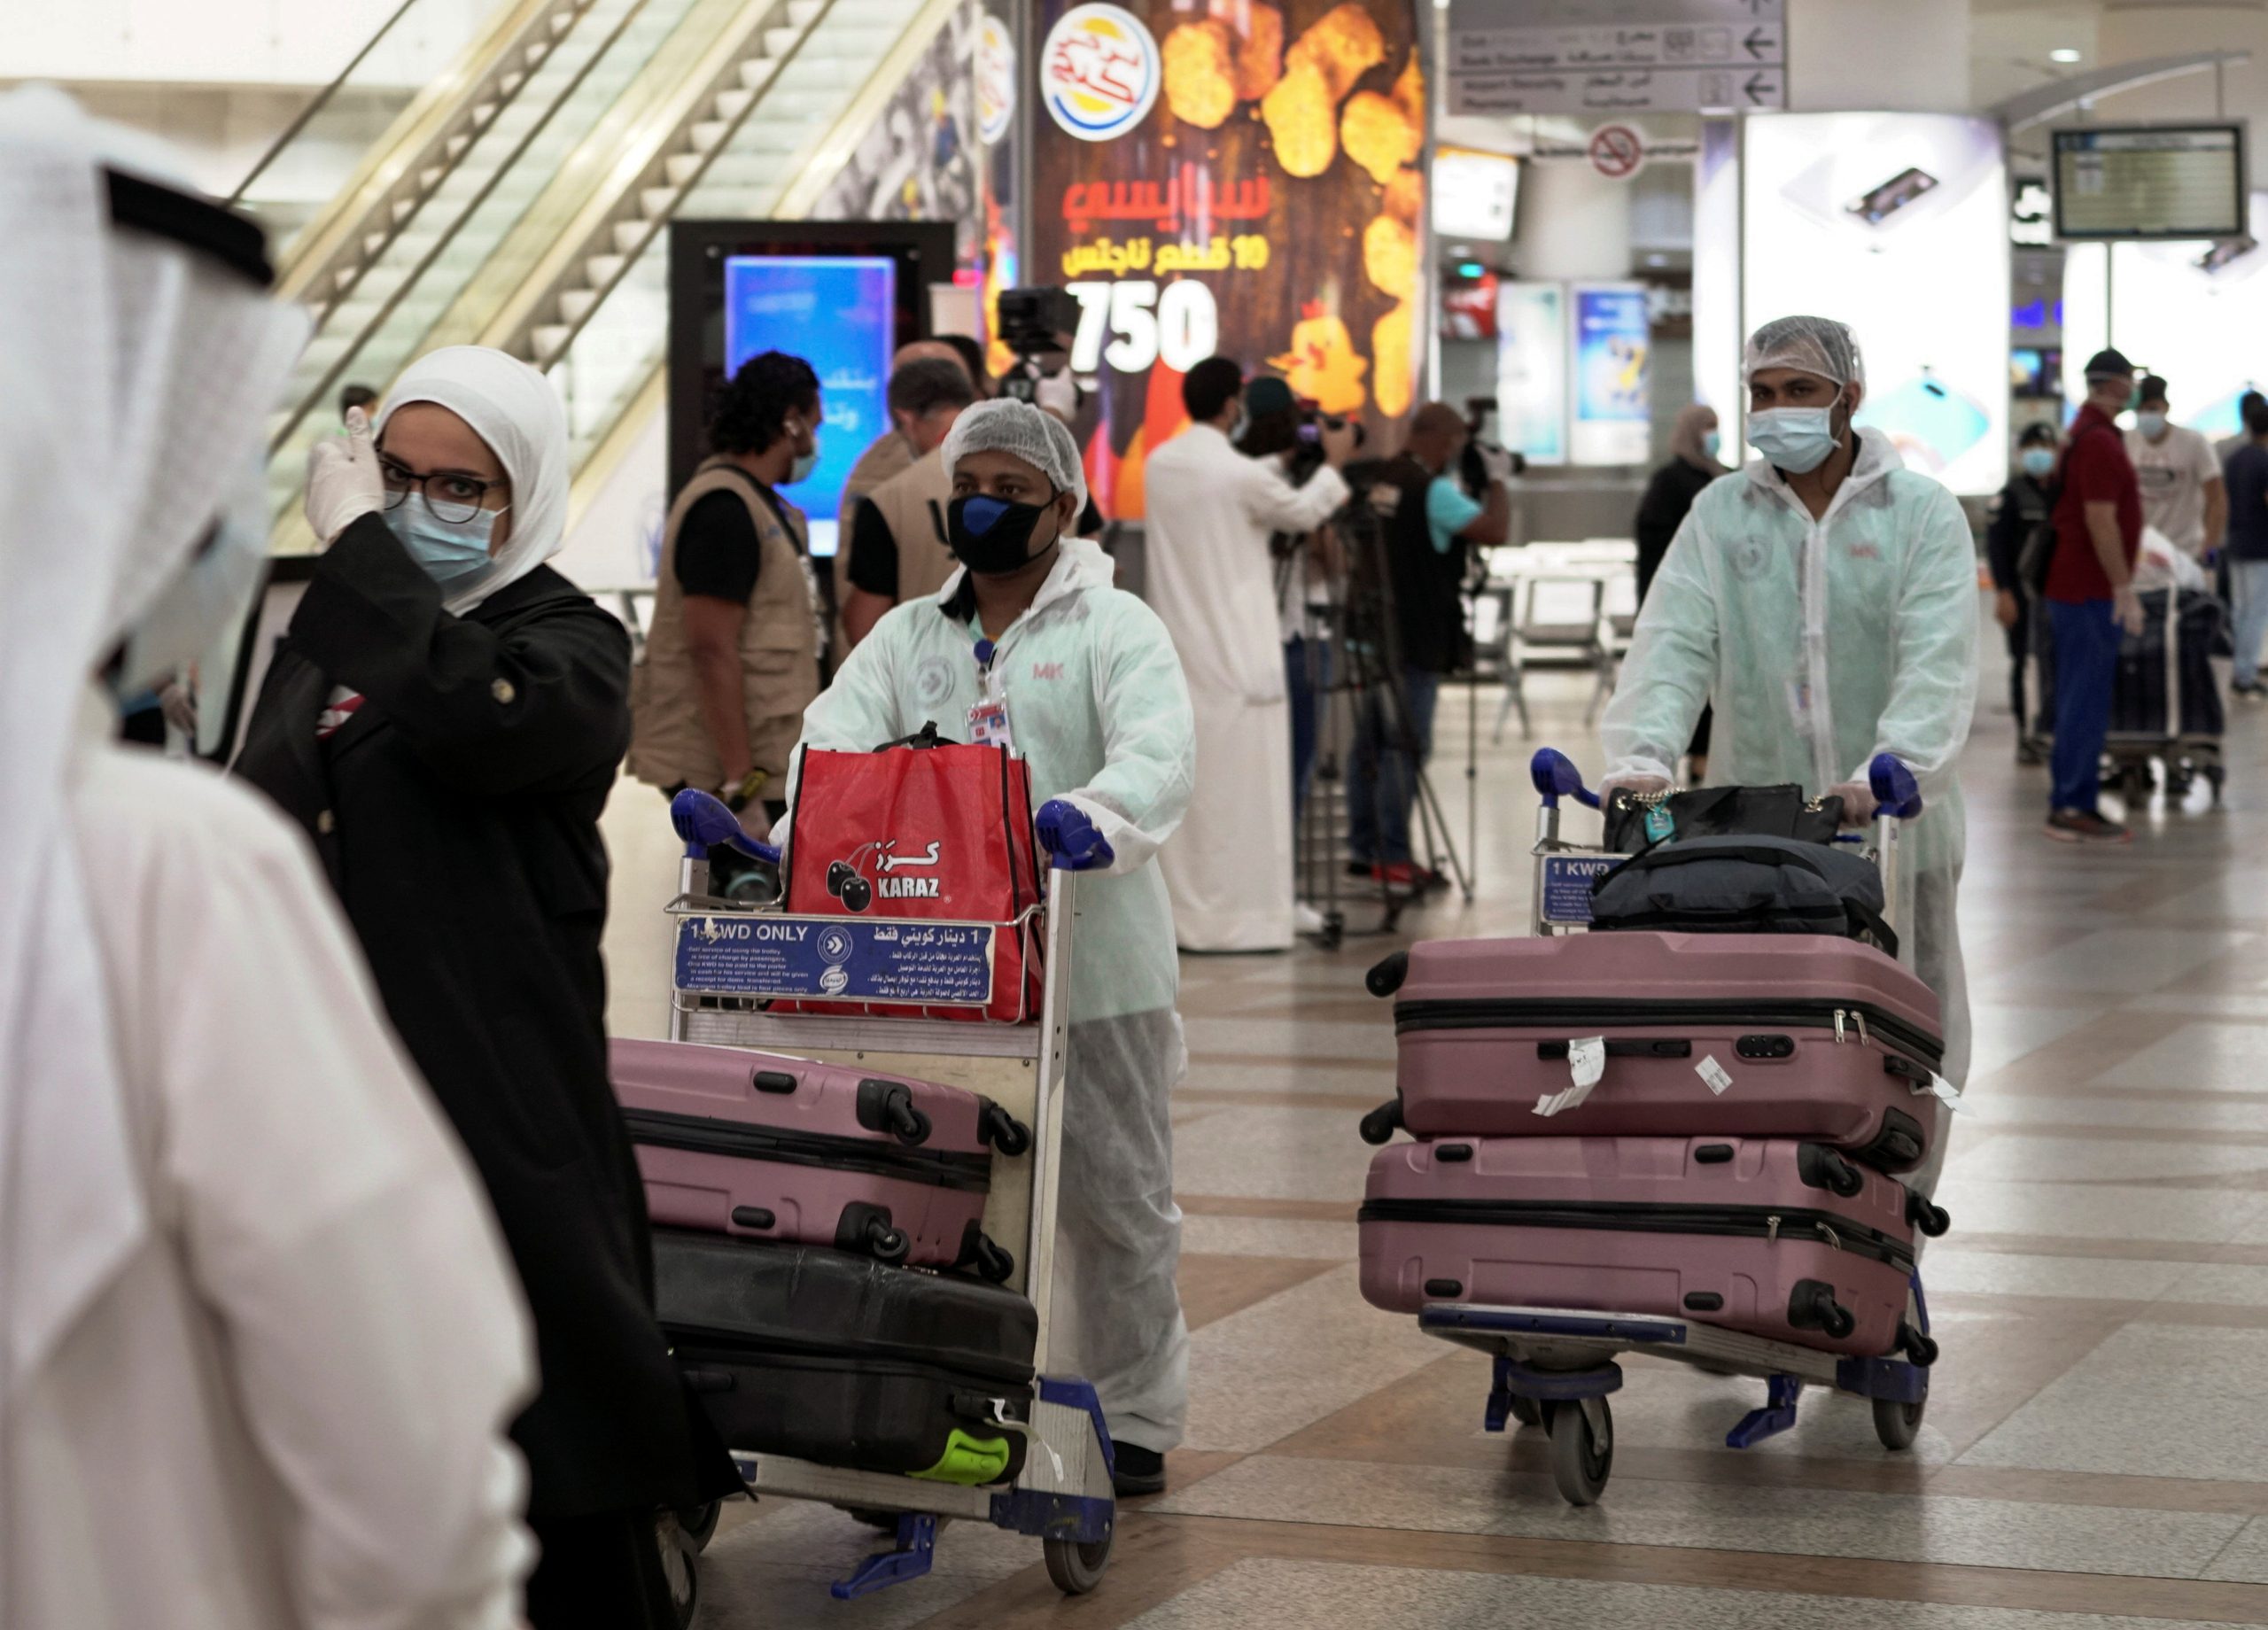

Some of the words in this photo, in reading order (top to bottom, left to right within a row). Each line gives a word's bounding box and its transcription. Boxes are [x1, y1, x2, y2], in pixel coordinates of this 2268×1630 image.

[1064, 279, 1218, 373] 750
[877, 877, 939, 898] KARAZ
[757, 925, 808, 942] ONLY
[874, 927, 898, 941] فقط
[901, 928, 936, 948] كويتي
[936, 928, 966, 947] دينار
